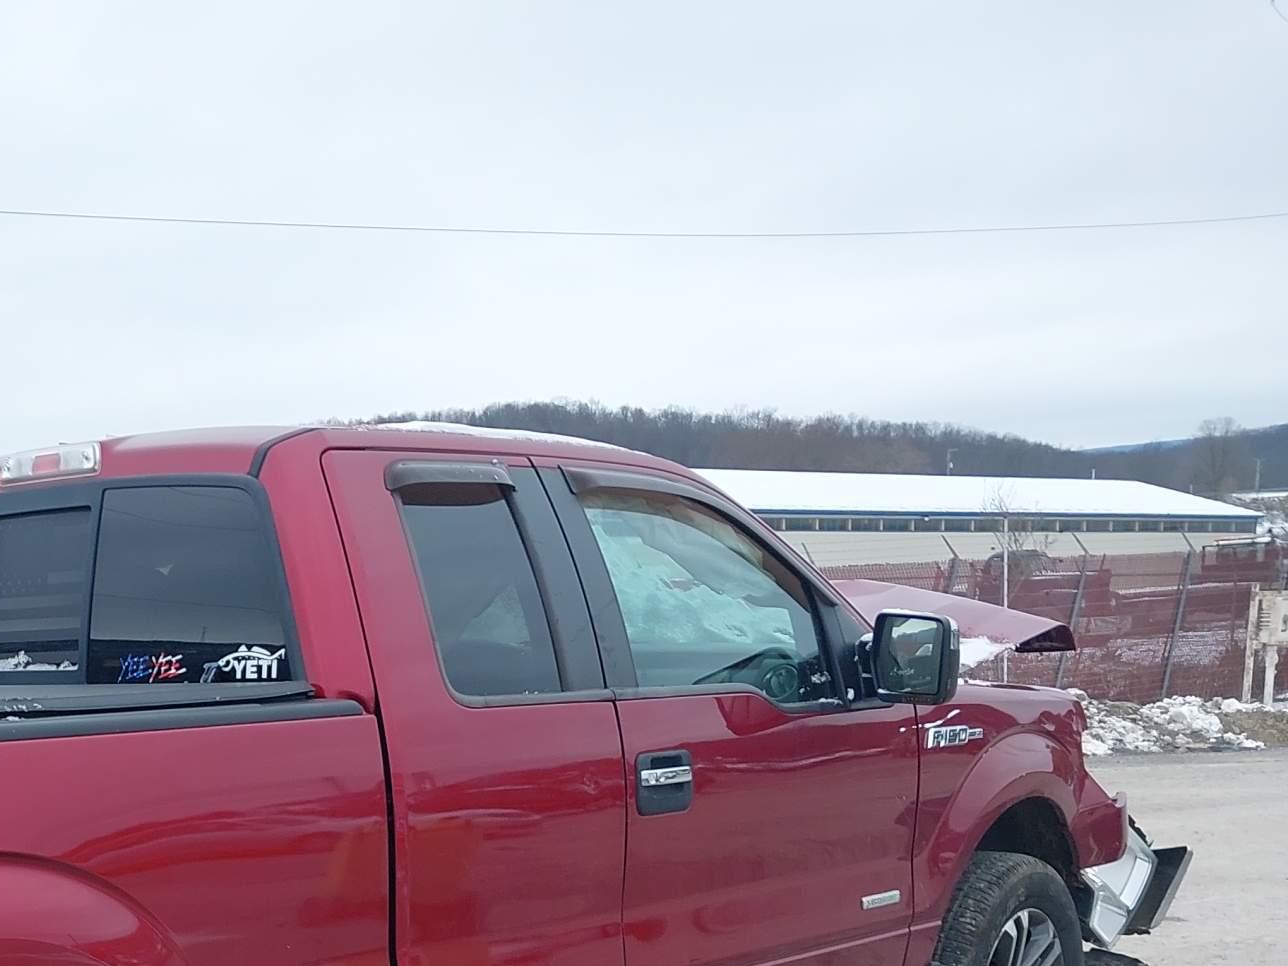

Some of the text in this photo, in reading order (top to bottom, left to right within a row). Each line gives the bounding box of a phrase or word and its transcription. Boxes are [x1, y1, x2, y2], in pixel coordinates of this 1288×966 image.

[117, 652, 187, 683] YEE YEE
[233, 659, 278, 679] YETI
